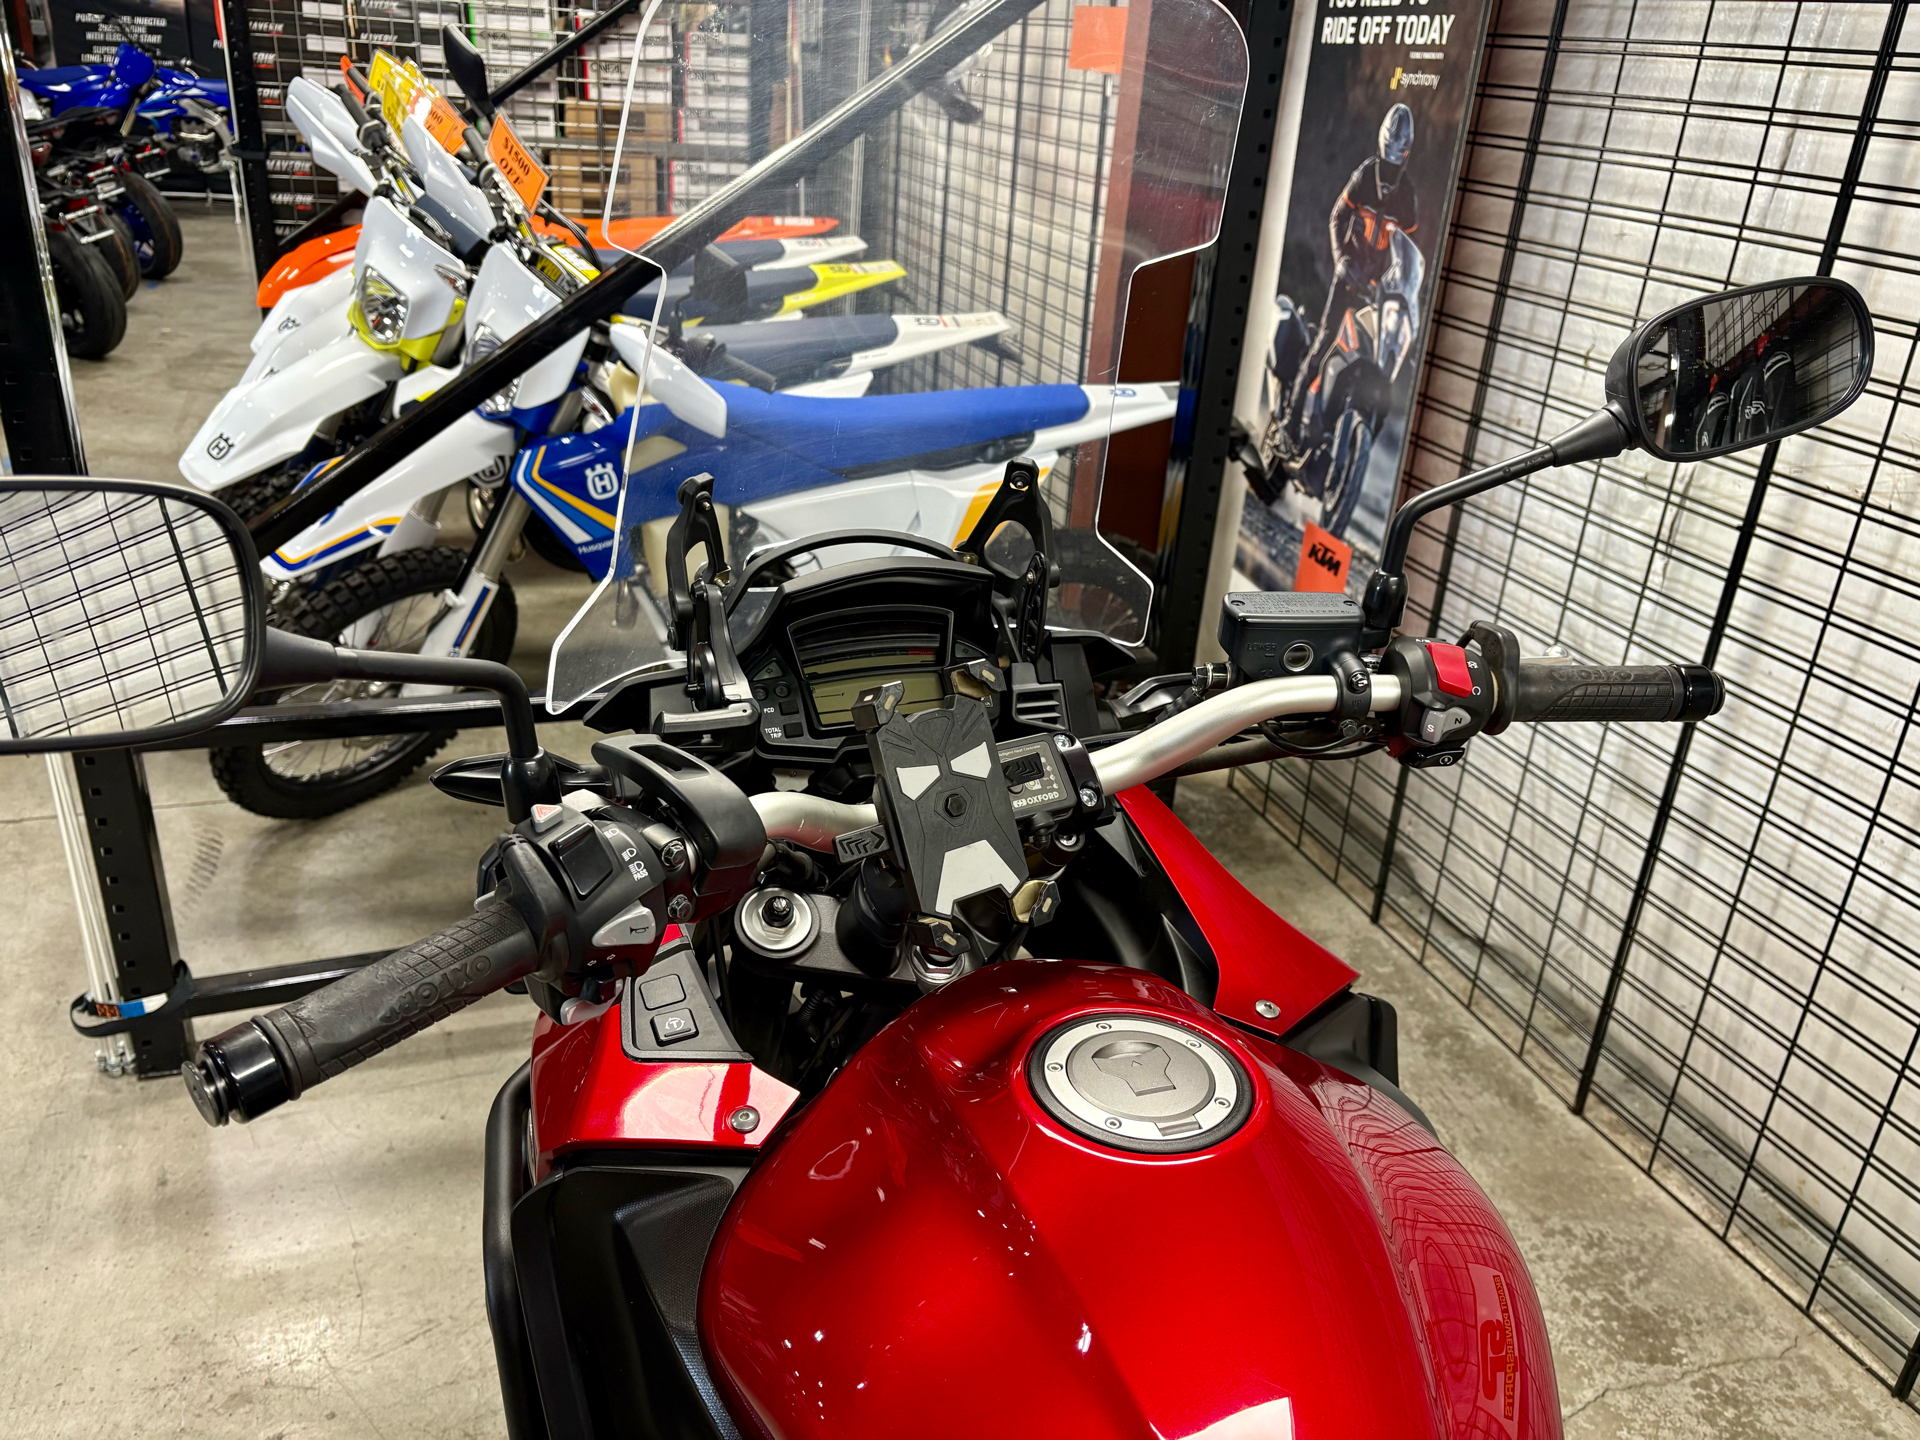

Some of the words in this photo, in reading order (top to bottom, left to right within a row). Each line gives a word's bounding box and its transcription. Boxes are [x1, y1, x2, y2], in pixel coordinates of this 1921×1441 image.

[1321, 16, 1359, 45] RIDE
[1358, 15, 1393, 45] OFF
[1395, 14, 1456, 45] TODAY
[140, 34, 163, 44] START
[1400, 70, 1441, 90] synchrony
[502, 136, 530, 176] $1500
[500, 157, 524, 185] OFF
[1308, 541, 1342, 577] KTM
[1247, 642, 1278, 652] LOWER
[1427, 724, 1435, 733] S
[1454, 717, 1463, 725] N
[1026, 791, 1060, 805] OXFORD
[632, 868, 649, 882] PASS
[379, 954, 492, 1025] OXFORD
